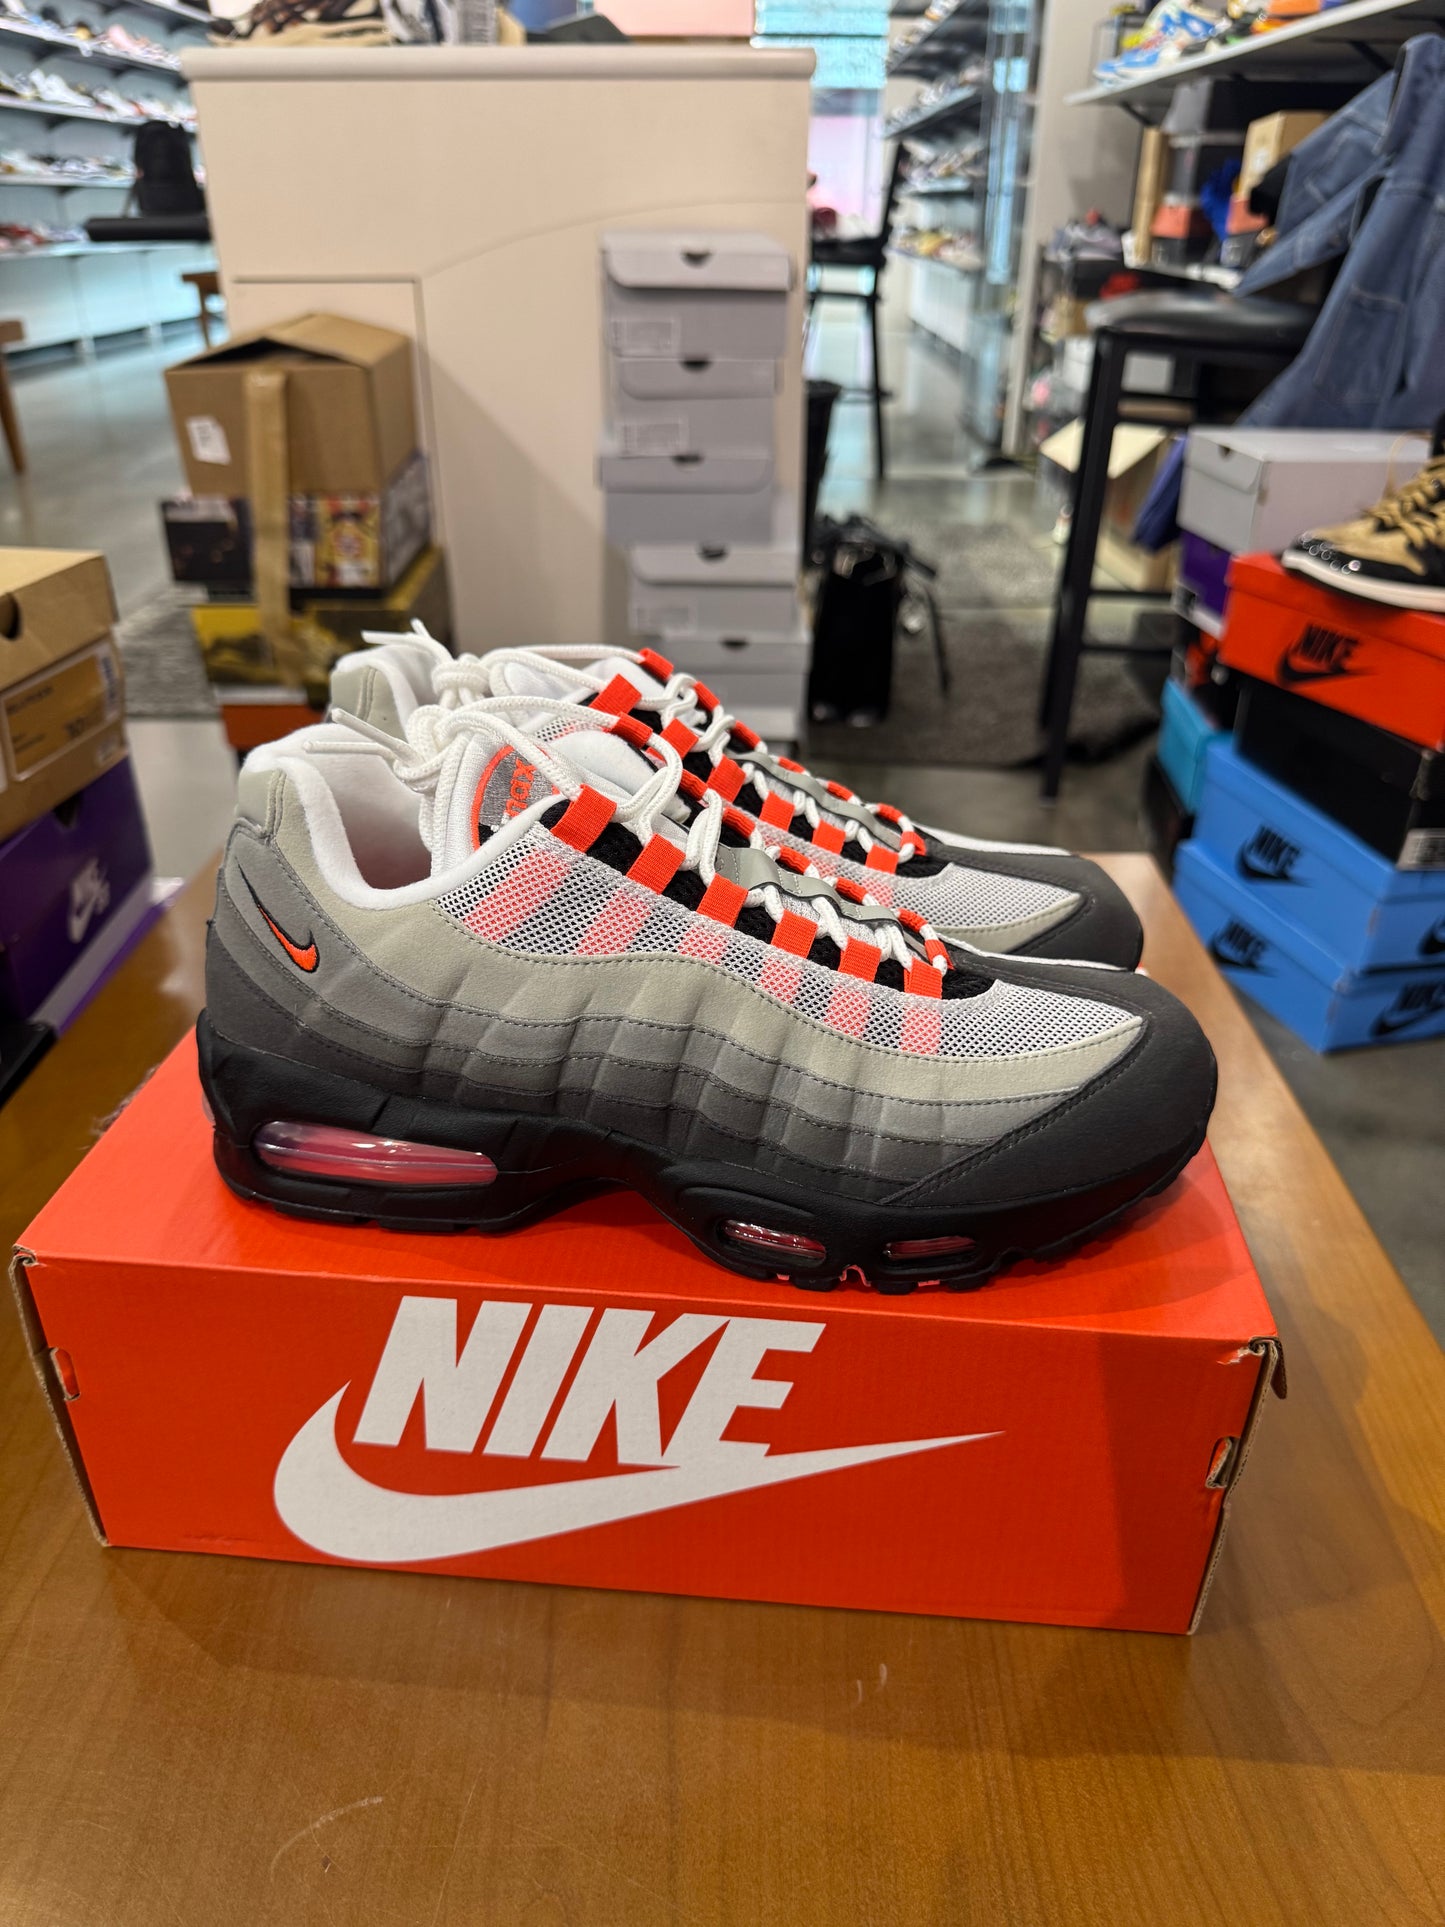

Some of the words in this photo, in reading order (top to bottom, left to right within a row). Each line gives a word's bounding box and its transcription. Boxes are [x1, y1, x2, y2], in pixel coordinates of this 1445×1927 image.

[1288, 622, 1360, 673] NIKE
[1245, 823, 1301, 879] NIKE
[1216, 917, 1266, 968] NIKE
[353, 1296, 826, 1468] NIKE
